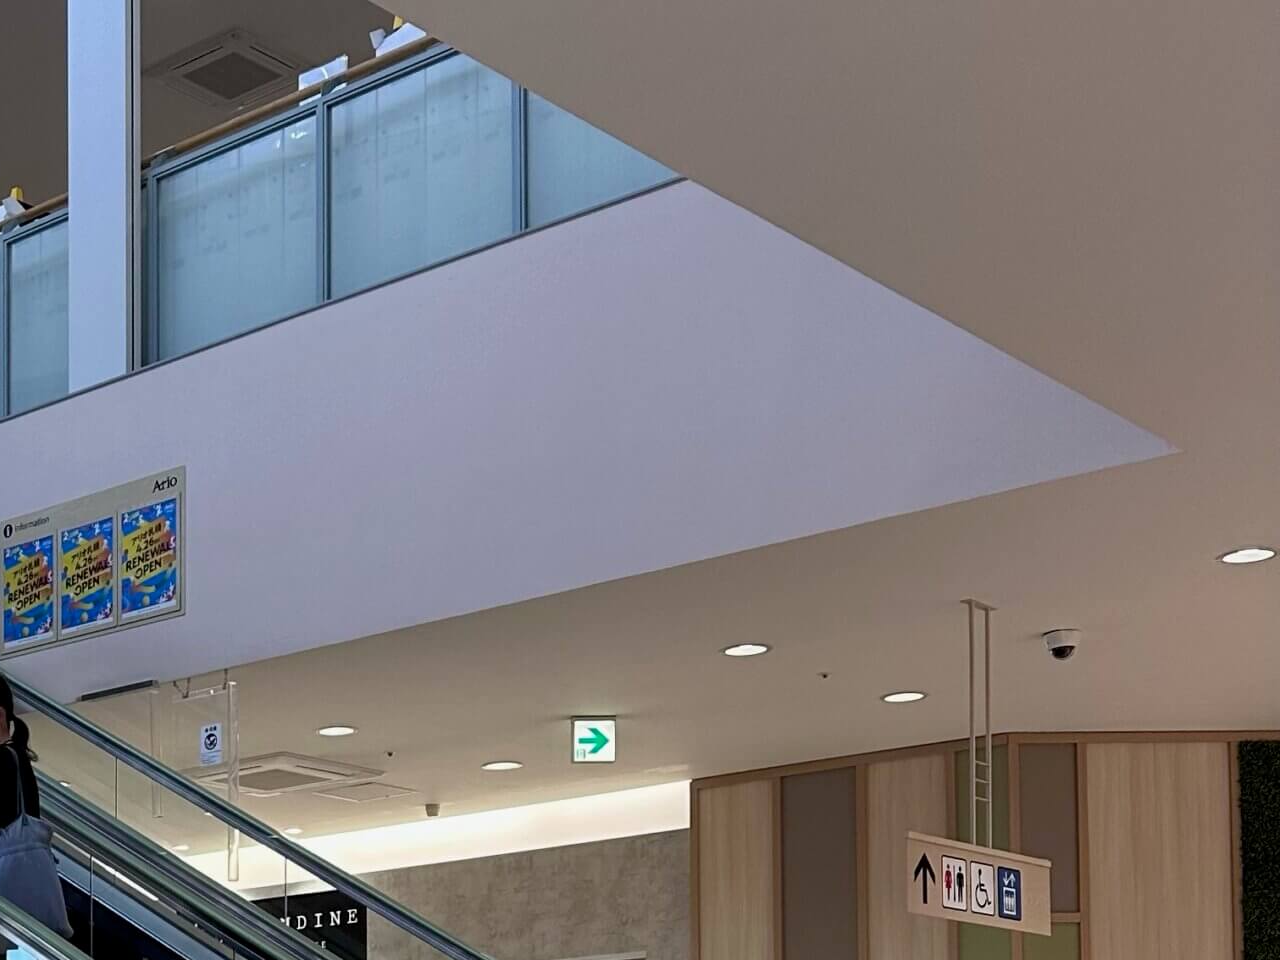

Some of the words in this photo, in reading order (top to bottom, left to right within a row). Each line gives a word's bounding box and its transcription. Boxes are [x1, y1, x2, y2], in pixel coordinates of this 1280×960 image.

[152, 476, 178, 494] Ario
[134, 558, 162, 580] OPEN
[74, 575, 100, 597] OPEN
[15, 591, 42, 612] OPEN
